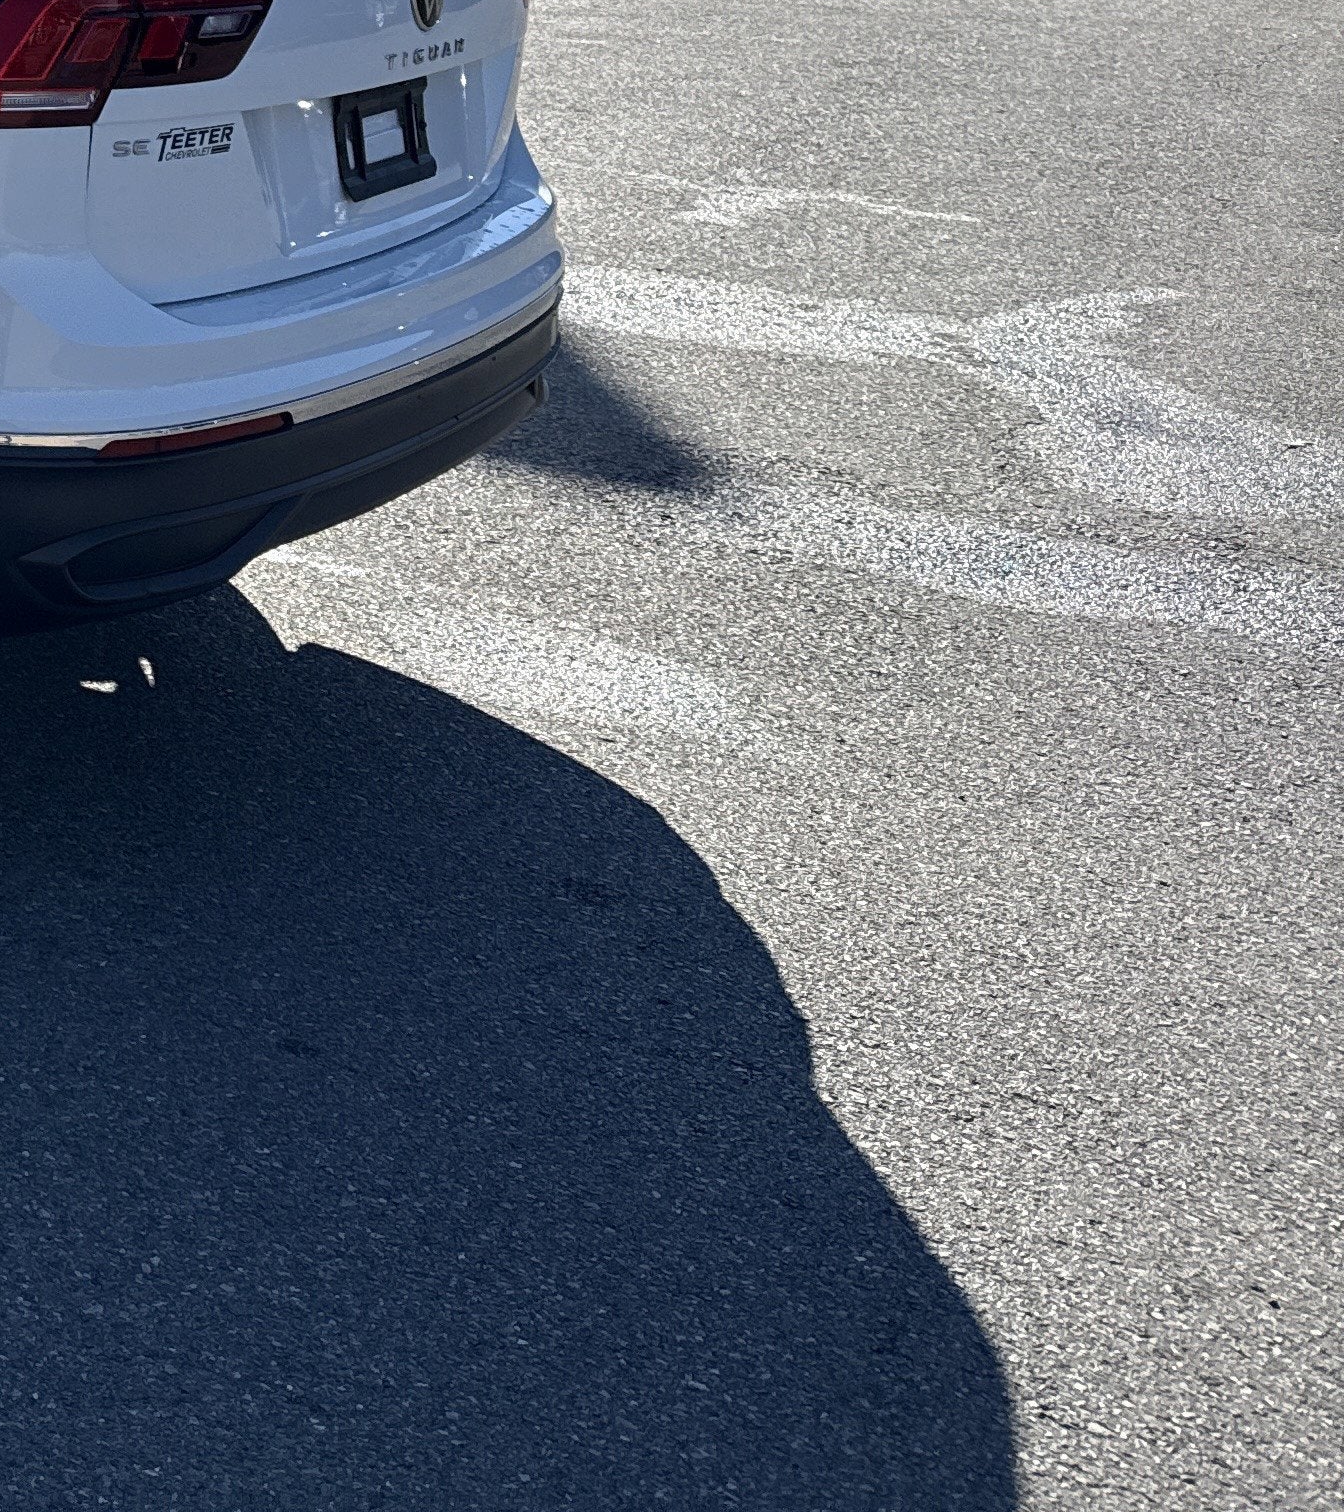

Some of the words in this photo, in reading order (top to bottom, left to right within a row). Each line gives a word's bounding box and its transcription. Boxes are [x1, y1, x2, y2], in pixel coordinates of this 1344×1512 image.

[384, 38, 464, 70] TIGUAN
[112, 139, 151, 157] SE
[157, 126, 233, 162] TEETER
[165, 147, 211, 161] CHEVROLET
